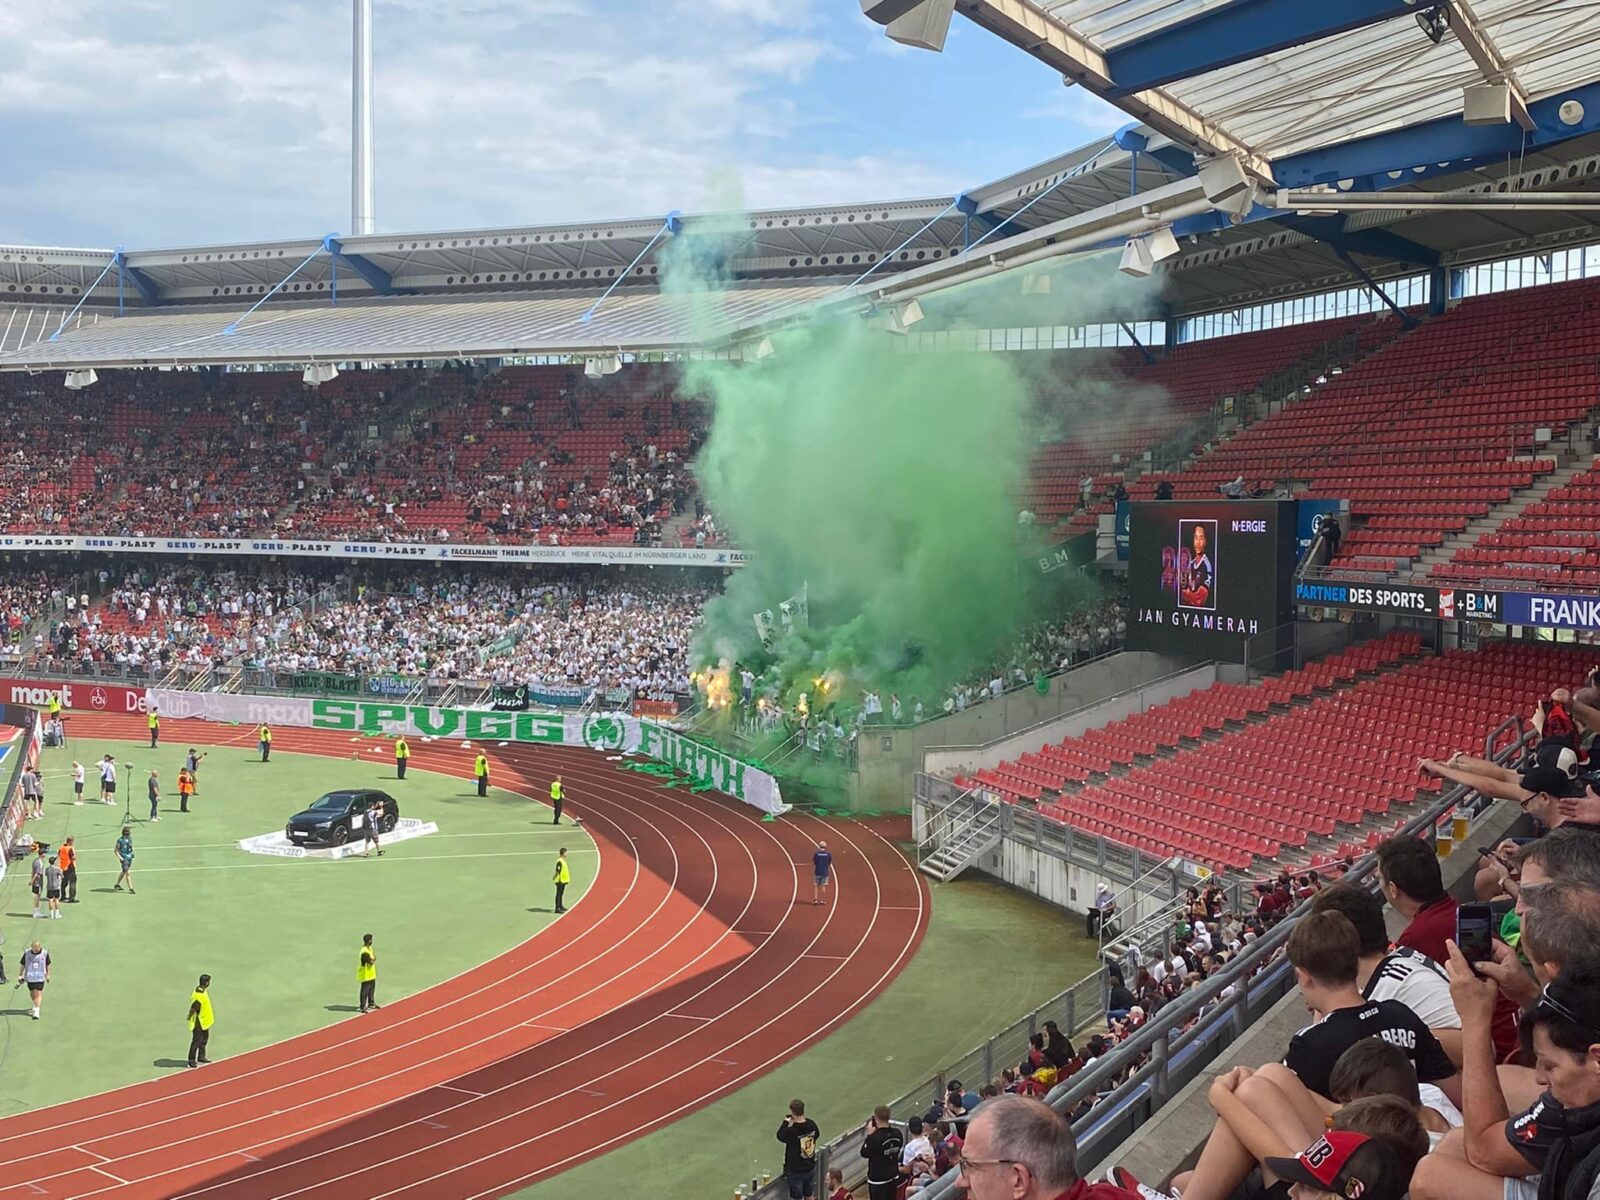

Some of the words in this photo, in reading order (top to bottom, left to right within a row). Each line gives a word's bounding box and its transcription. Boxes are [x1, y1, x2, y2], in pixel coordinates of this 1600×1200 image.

[451, 548, 498, 556] FACKELMANN
[531, 550, 566, 558] HERSBRUCK
[592, 551, 632, 560] VITALQUELLE
[642, 551, 687, 560] NÜRNBERGER
[1296, 584, 1347, 602] PARTNER
[1349, 588, 1373, 605] DES
[1466, 593, 1497, 612] B&M
[1138, 608, 1163, 624] JAN
[1171, 611, 1258, 635] GYAMERAH
[126, 691, 149, 714] De
[646, 689, 675, 703] SpVgg
[312, 700, 564, 743] SPVGG
[637, 721, 746, 800] FÜRTH
